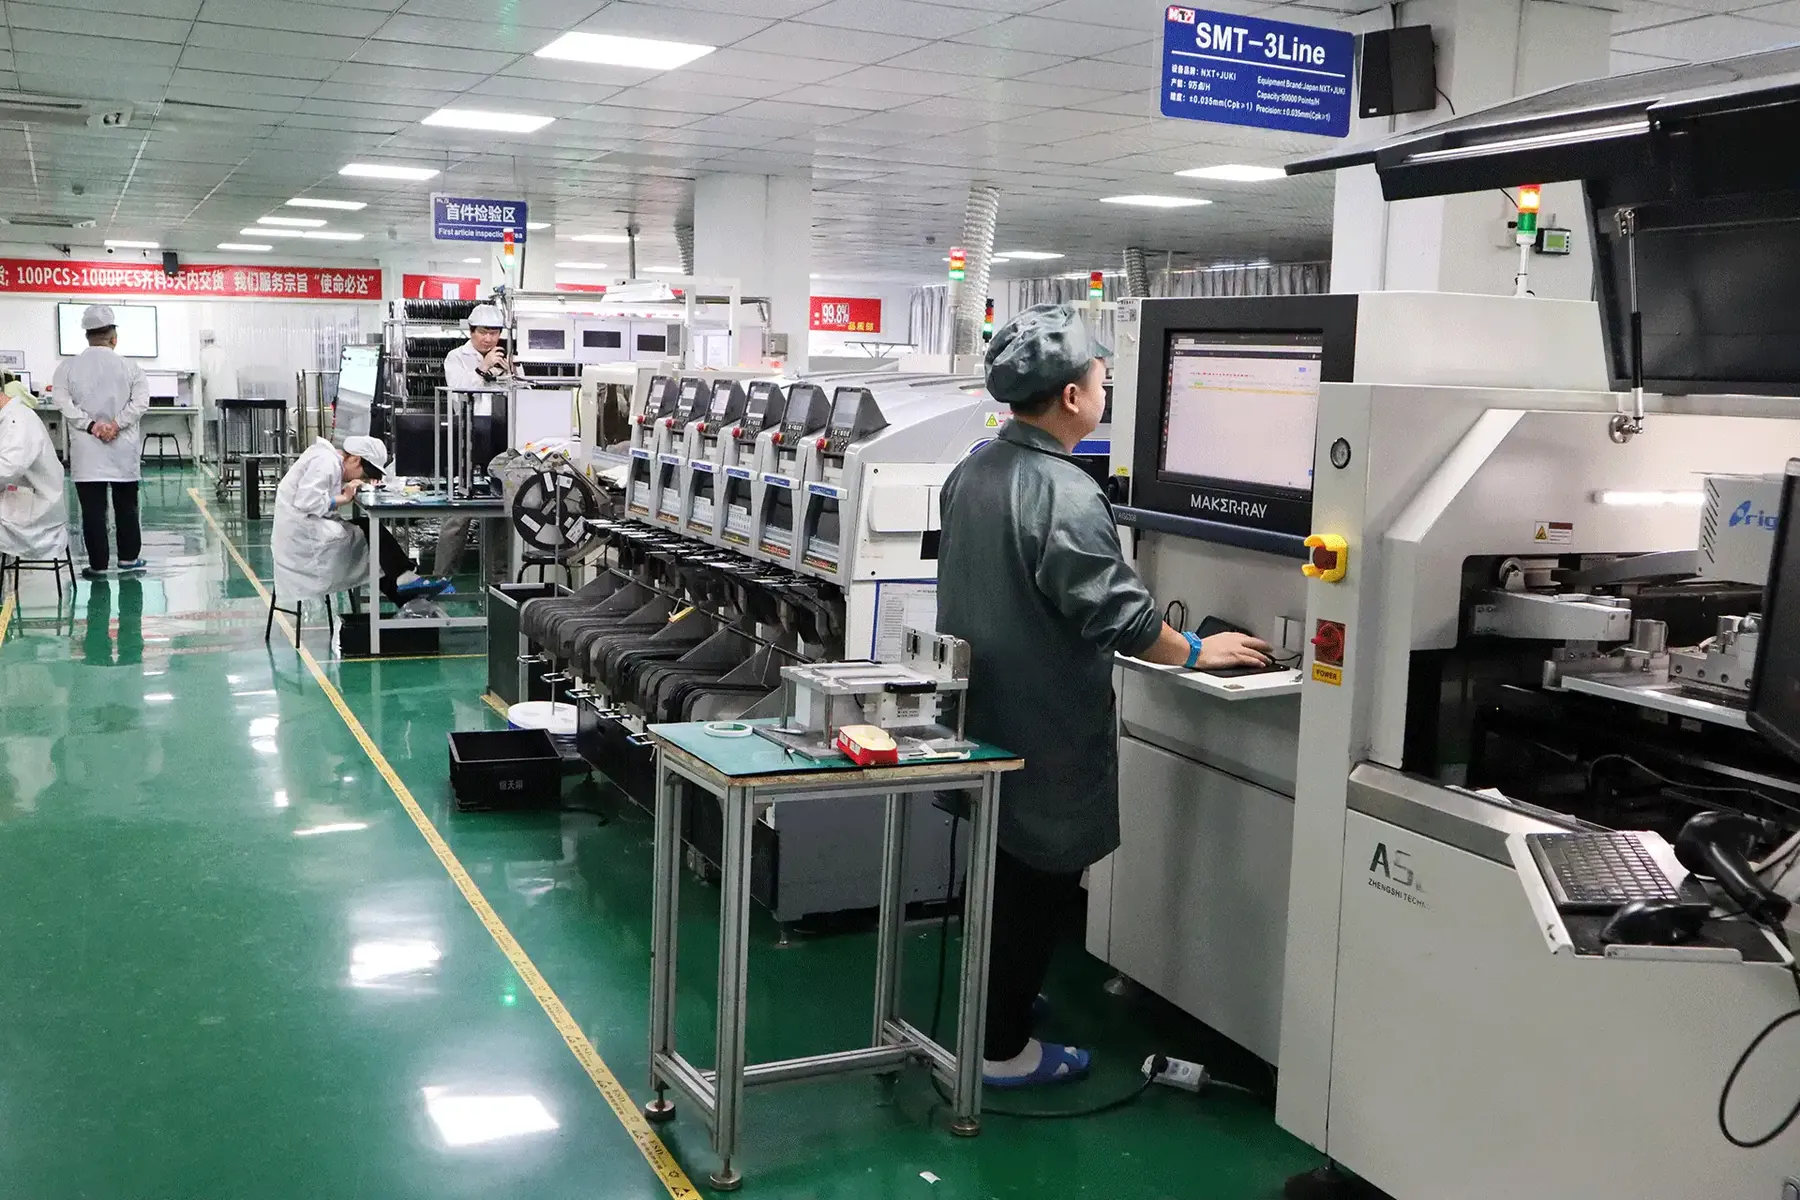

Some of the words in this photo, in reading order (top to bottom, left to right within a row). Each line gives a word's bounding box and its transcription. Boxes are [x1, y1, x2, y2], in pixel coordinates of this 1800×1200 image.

[1195, 22, 1326, 65] SMT-3Line
[1257, 76, 1285, 88] Equipment
[445, 202, 516, 223] 首件检验区
[438, 227, 454, 236] First
[454, 229, 474, 237] article
[475, 229, 505, 239] inspectio
[1190, 493, 1268, 519] MAKER-RAY
[1316, 669, 1337, 681] POWER
